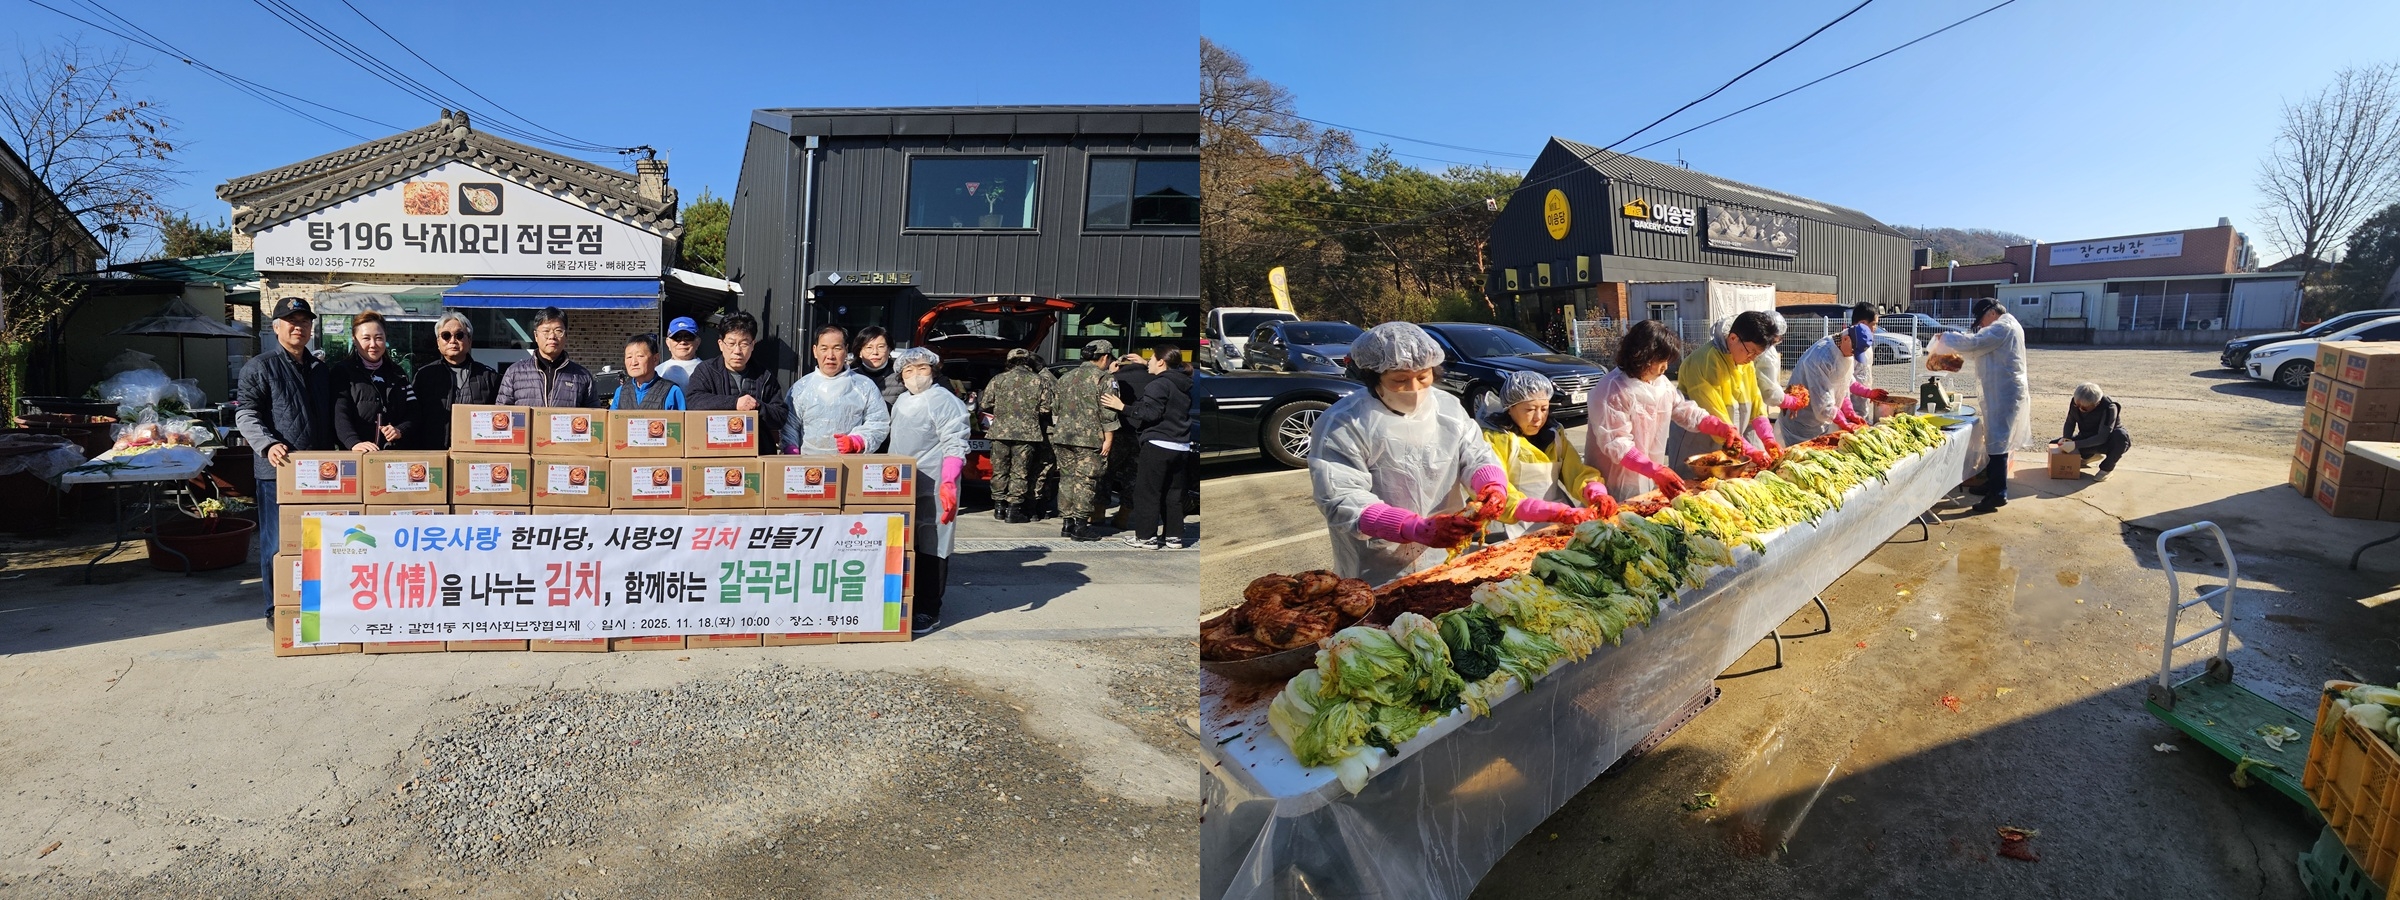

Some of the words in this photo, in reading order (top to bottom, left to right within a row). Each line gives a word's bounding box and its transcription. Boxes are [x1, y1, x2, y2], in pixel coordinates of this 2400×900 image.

[1547, 210, 1566, 227] 이송당
[1652, 203, 1696, 227] 이송당
[308, 221, 393, 252] 탕196
[402, 222, 508, 255] 낙지요리
[516, 223, 603, 255] 전문점
[265, 256, 305, 267] 예약전화
[546, 260, 598, 271] 해물감자탕
[605, 260, 647, 271] 뼈해장국
[393, 526, 502, 552] 이웃사랑
[511, 526, 594, 551] 한마당,
[604, 526, 684, 551] 사랑의
[691, 526, 742, 551] 김치
[747, 525, 824, 550] 만들기
[834, 539, 883, 549] 사랑의열매
[470, 572, 537, 607] 나누는
[545, 560, 611, 608] 김치,
[624, 570, 707, 605] 함께하는
[718, 559, 802, 604] 갈곡리
[811, 558, 867, 603] 마을
[365, 622, 394, 635] 주관
[408, 622, 457, 634] 갈현1동
[462, 619, 581, 633] 지역사회보장협의체
[602, 619, 626, 631] 일시
[640, 618, 671, 629] 2025.
[676, 618, 693, 628] 11.
[740, 616, 770, 627] 10:00
[789, 615, 814, 627] 장소
[827, 615, 859, 626] 탕196
